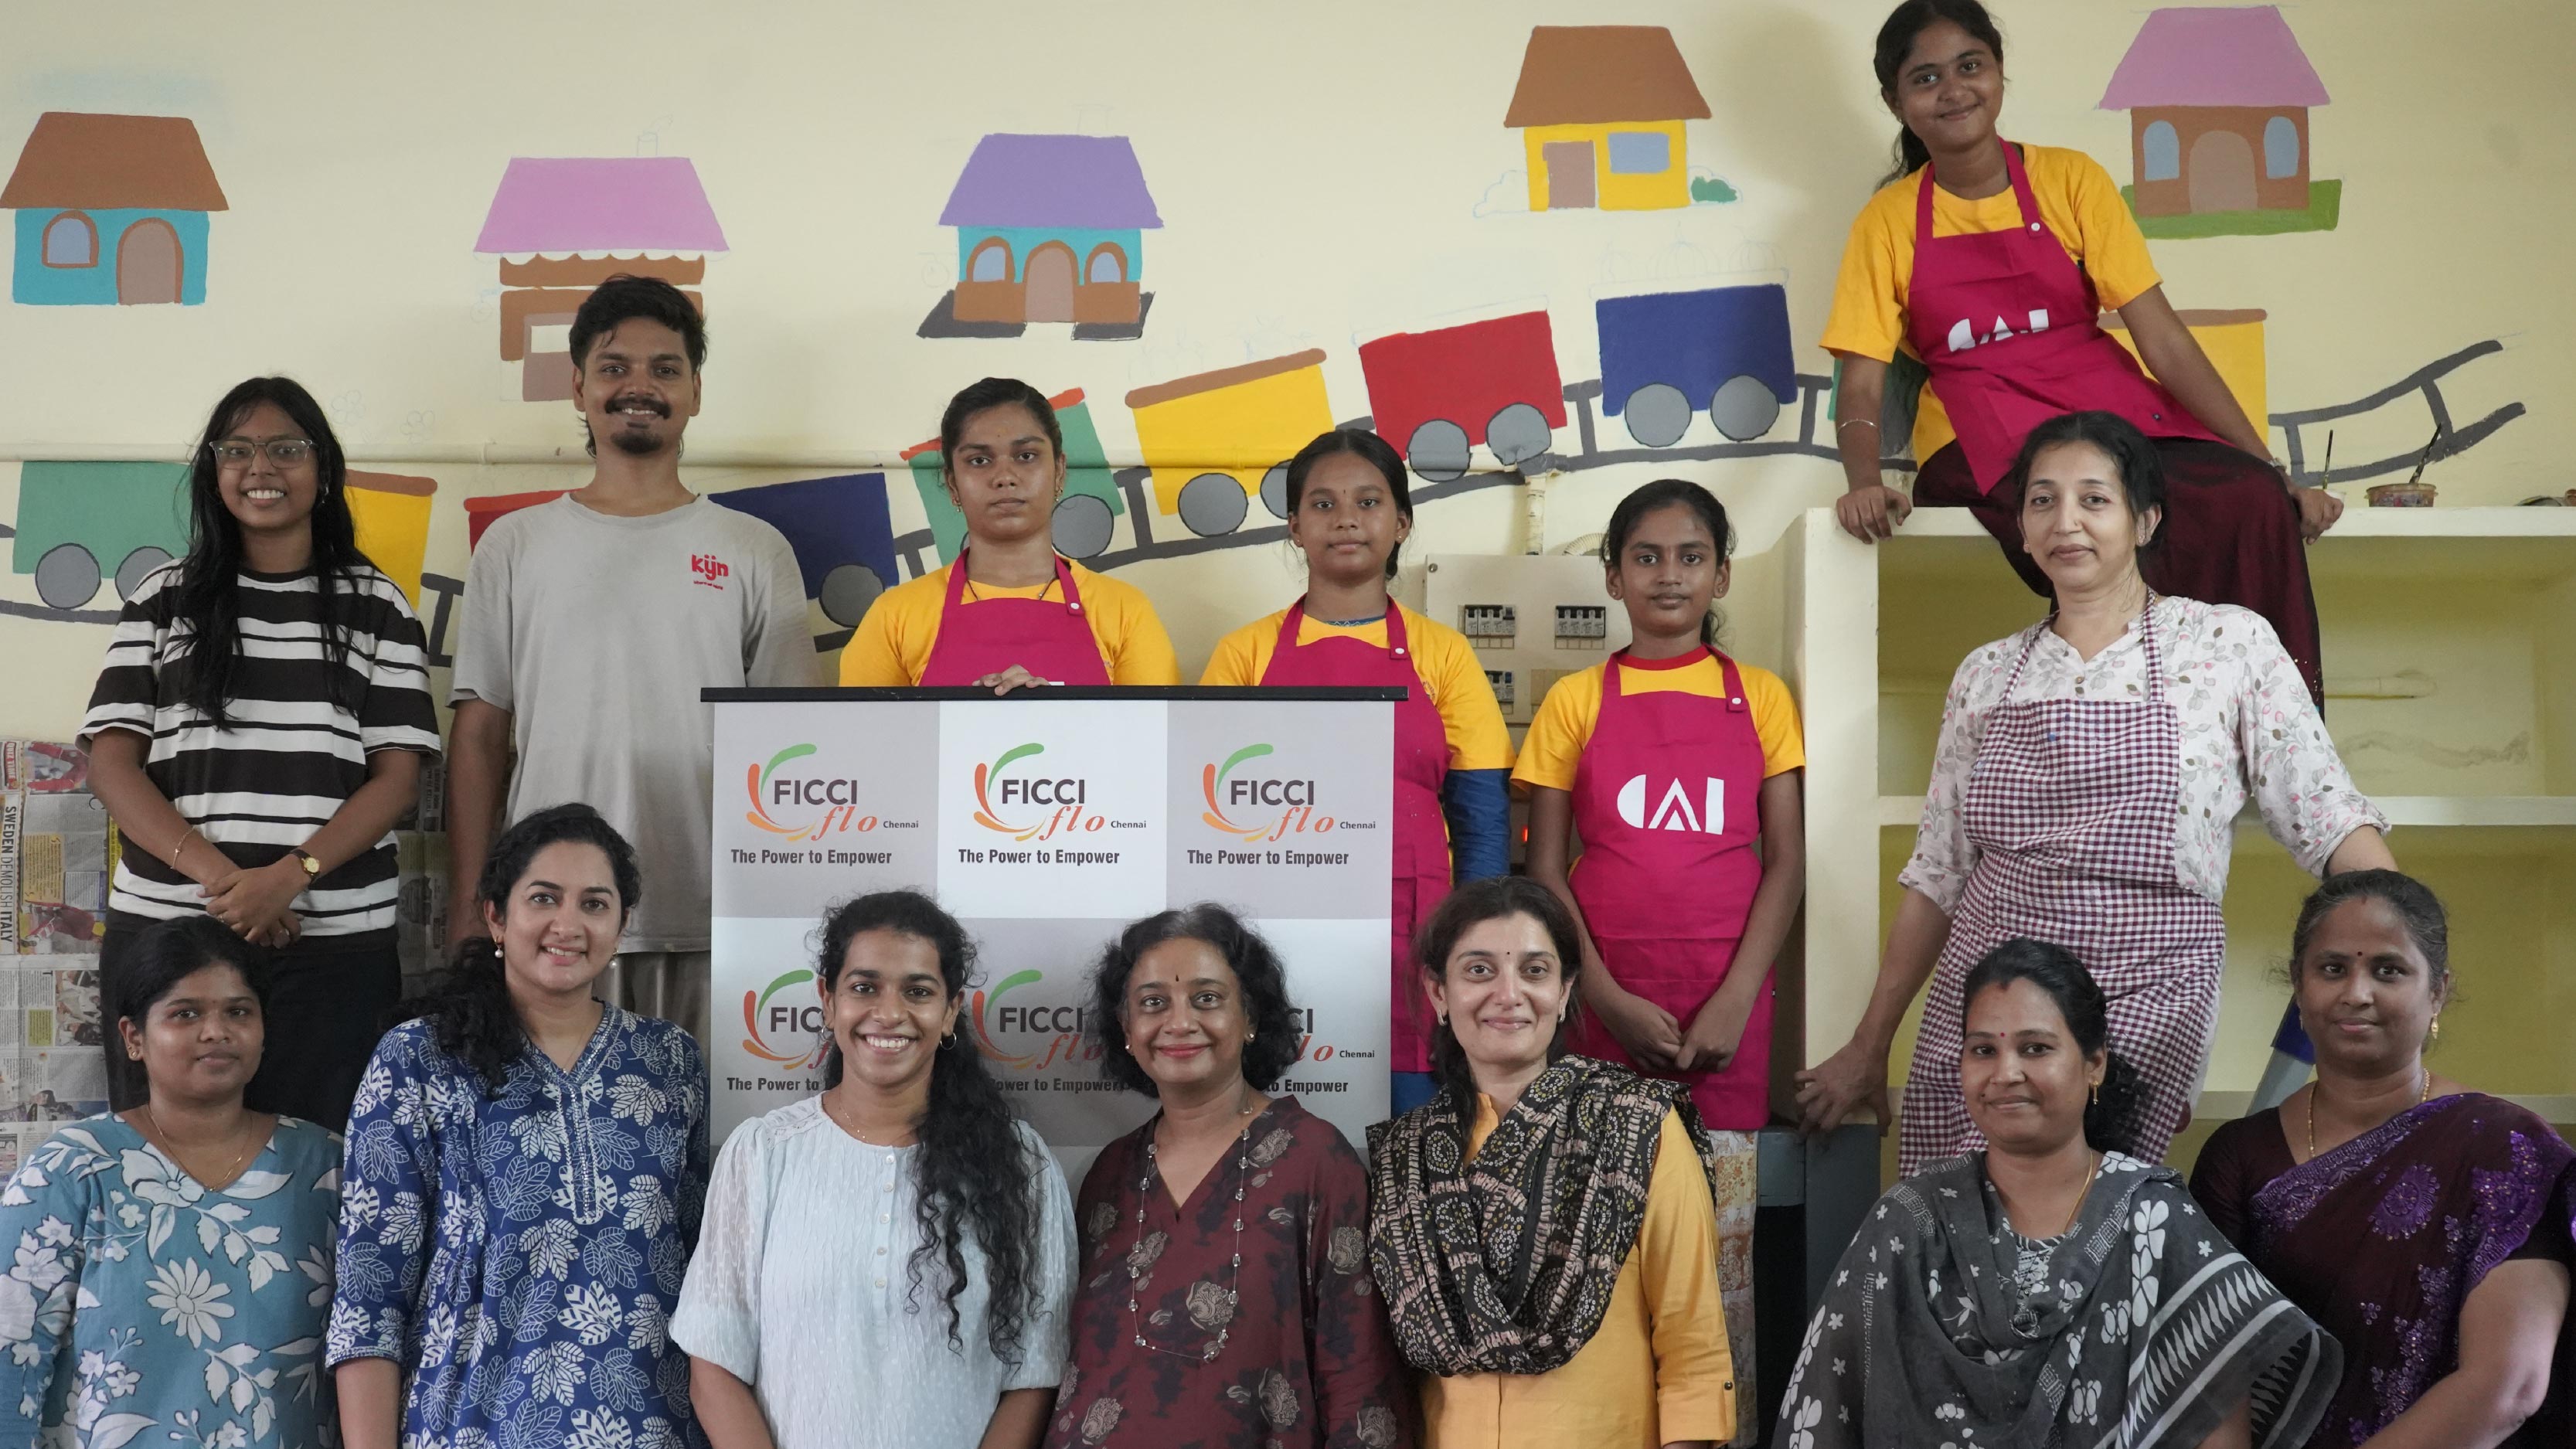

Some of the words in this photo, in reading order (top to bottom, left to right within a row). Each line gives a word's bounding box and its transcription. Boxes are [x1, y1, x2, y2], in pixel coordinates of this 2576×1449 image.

[774, 779, 857, 805] FICCI
[1002, 778, 1085, 804] FICCI
[1230, 779, 1315, 806] FICCI
[2, 806, 16, 853] SWEDEN
[811, 806, 878, 841] flo
[1039, 805, 1105, 841] flo
[1268, 806, 1335, 842] flo
[1339, 821, 1376, 829] Chennai
[730, 849, 756, 864] The
[761, 849, 804, 864] Power
[808, 850, 822, 864] to
[828, 849, 892, 866] Empower
[958, 849, 984, 864] The
[989, 849, 1032, 864] Power
[1036, 850, 1050, 864] to
[1056, 849, 1120, 866] Empower
[1187, 849, 1213, 864] The
[1218, 849, 1261, 865] Power
[1266, 850, 1280, 865] to
[1285, 850, 1349, 867] Empower
[0, 857, 13, 908] DEMOLISH
[0, 911, 12, 942] ITALY
[771, 1006, 822, 1032] FIC
[1000, 1006, 1083, 1032] FICCI
[1294, 1036, 1333, 1061] lo
[1339, 1050, 1375, 1059] Chennai
[727, 1077, 752, 1091] The
[758, 1077, 801, 1091] Power
[805, 1078, 819, 1091] to
[989, 1078, 1029, 1091] ower
[1034, 1078, 1048, 1091] to
[1285, 1079, 1349, 1095] Empower
